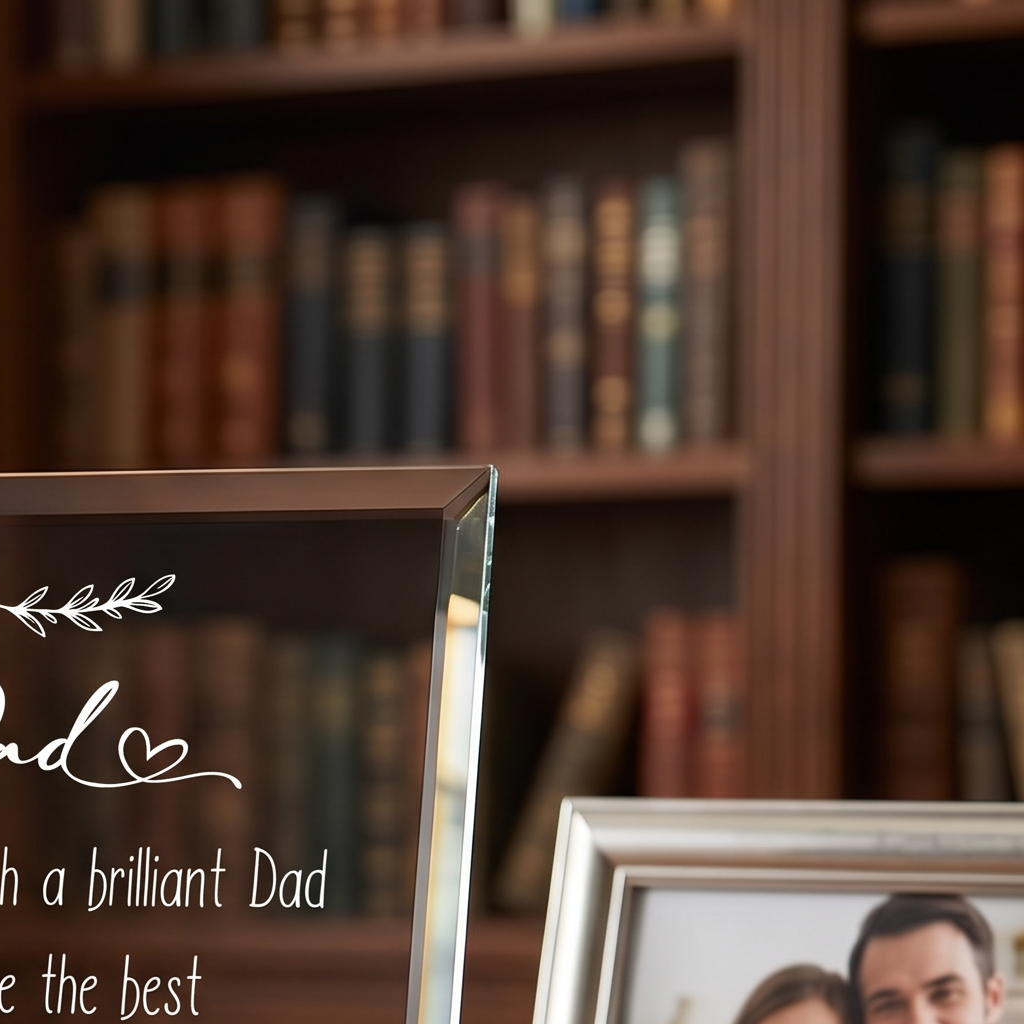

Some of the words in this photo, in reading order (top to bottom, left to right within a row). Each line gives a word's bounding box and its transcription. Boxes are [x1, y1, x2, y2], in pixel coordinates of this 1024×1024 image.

[42, 867, 66, 907] a
[87, 846, 227, 912] brilliant
[248, 846, 328, 909] Dad
[41, 953, 98, 1015] the
[120, 953, 203, 1021] best
